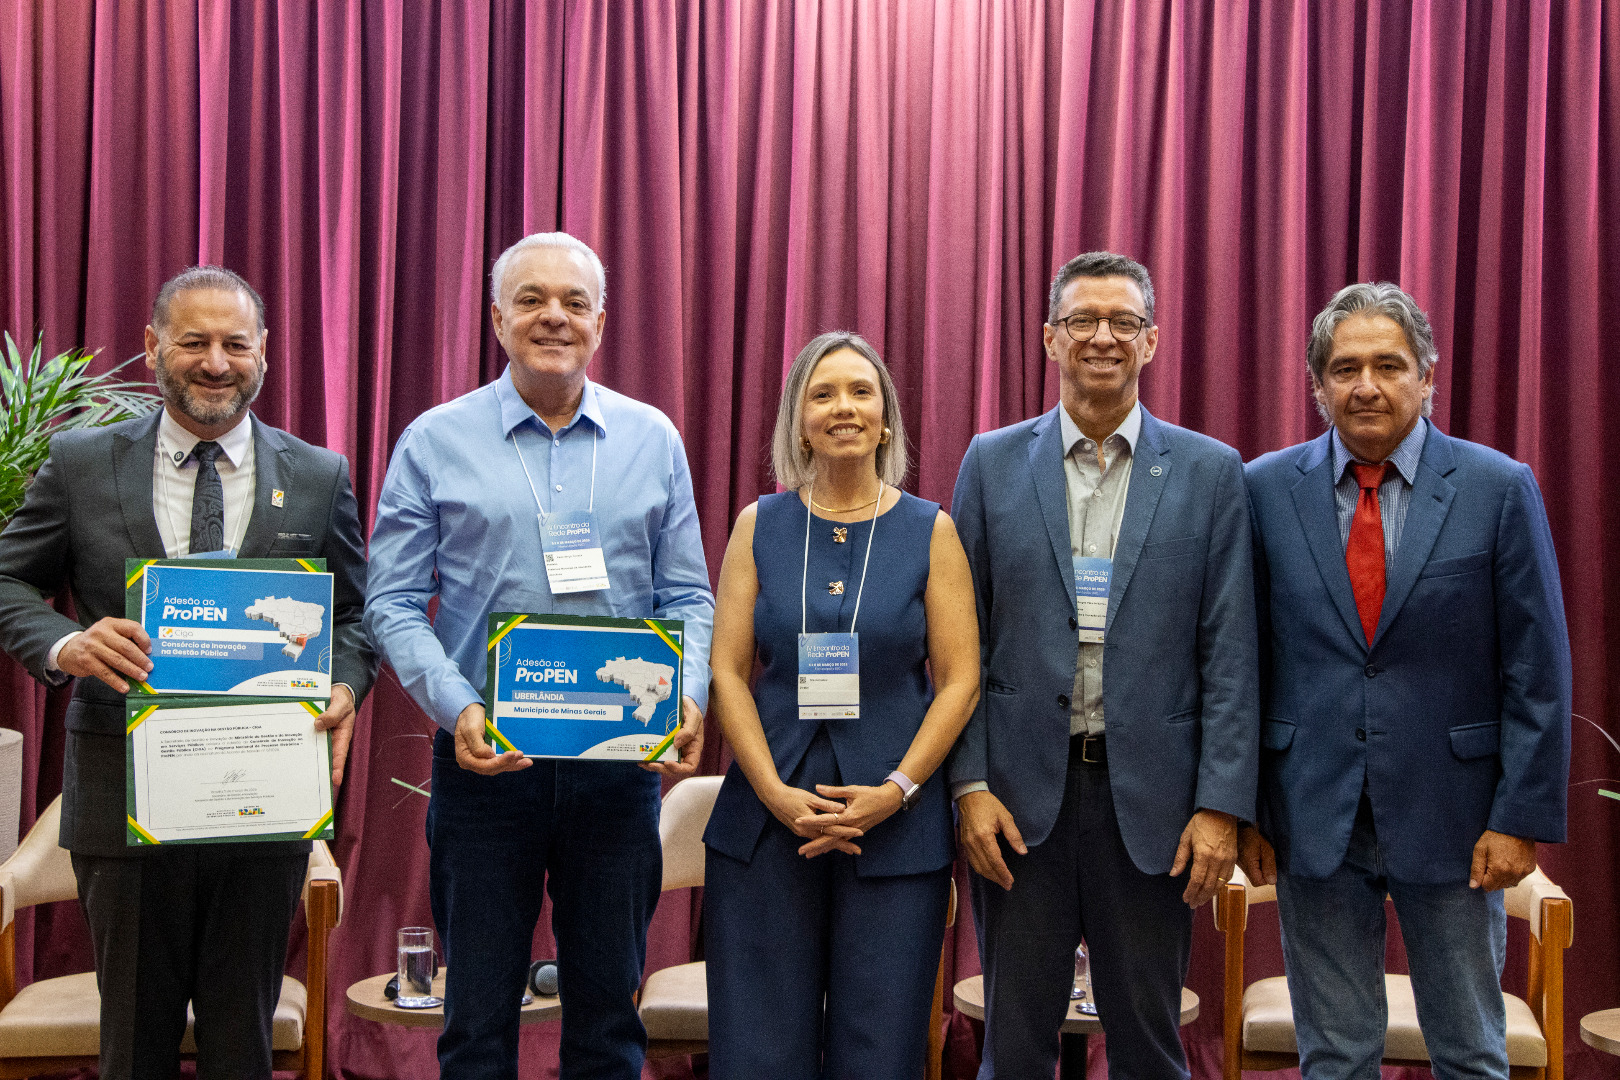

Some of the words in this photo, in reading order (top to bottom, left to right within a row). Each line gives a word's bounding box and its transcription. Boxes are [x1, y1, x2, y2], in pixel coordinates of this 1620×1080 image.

[553, 522, 580, 530] Encontro
[566, 528, 590, 536] ProPEN
[164, 596, 200, 606] Adesão
[162, 605, 227, 622] ProPEN
[174, 629, 194, 638] Ciga
[161, 641, 199, 650] Consórcio
[211, 642, 246, 651] Inovação
[516, 658, 552, 667] Adesão
[515, 667, 577, 684] ProPEN
[290, 680, 319, 688] BRASIL
[514, 691, 565, 701] UBERLÂNDIA
[514, 706, 549, 715] Município
[238, 808, 265, 816] BRASIL
